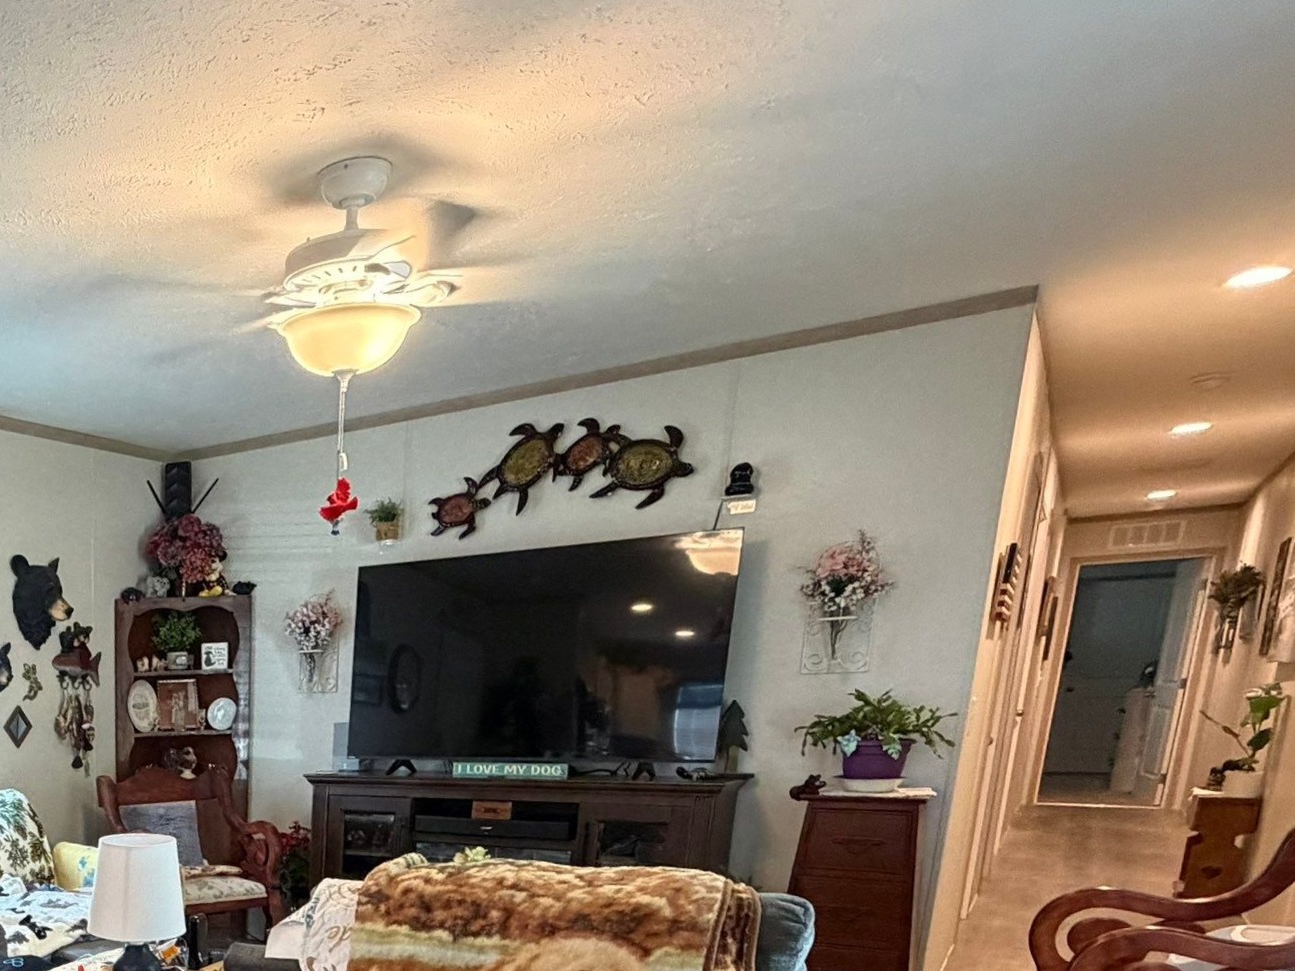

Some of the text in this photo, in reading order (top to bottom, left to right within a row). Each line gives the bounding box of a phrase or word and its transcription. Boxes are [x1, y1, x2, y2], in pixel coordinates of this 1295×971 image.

[466, 764, 500, 775] LOVE
[504, 764, 527, 775] MY
[531, 764, 562, 776] DOG
